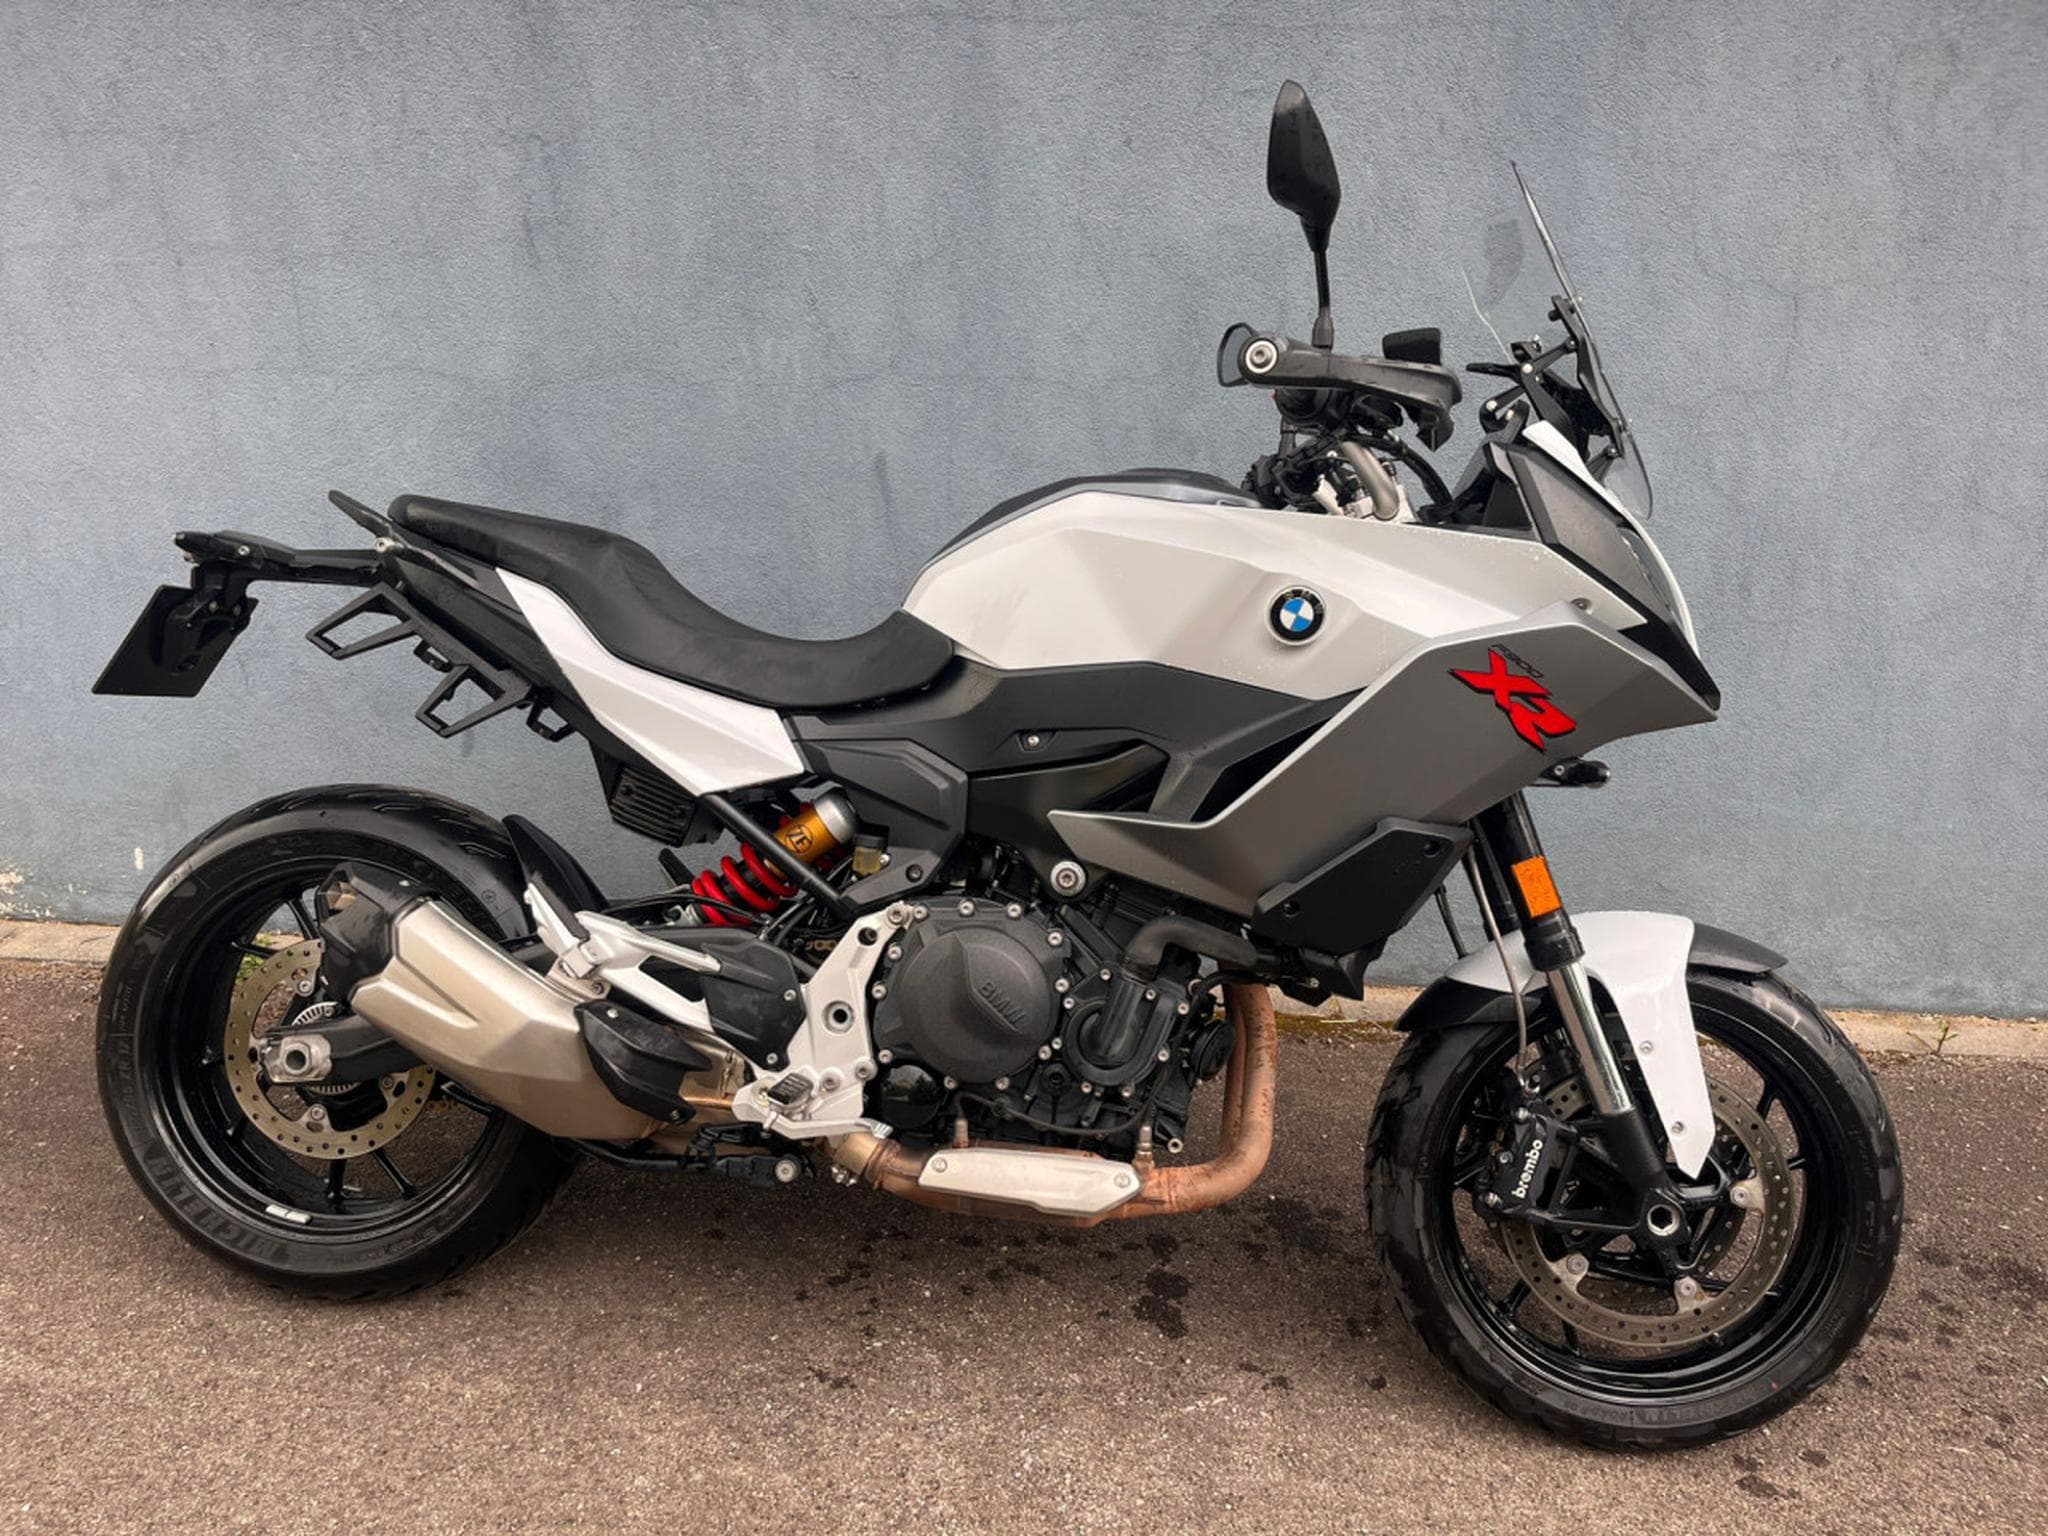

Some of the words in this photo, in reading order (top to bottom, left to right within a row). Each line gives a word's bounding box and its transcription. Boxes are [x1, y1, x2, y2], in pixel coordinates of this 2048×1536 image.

[1447, 647, 1577, 754] XR
[785, 825, 813, 853] ZF
[978, 980, 1027, 1027] BMW
[1511, 1139, 1543, 1199] brembo
